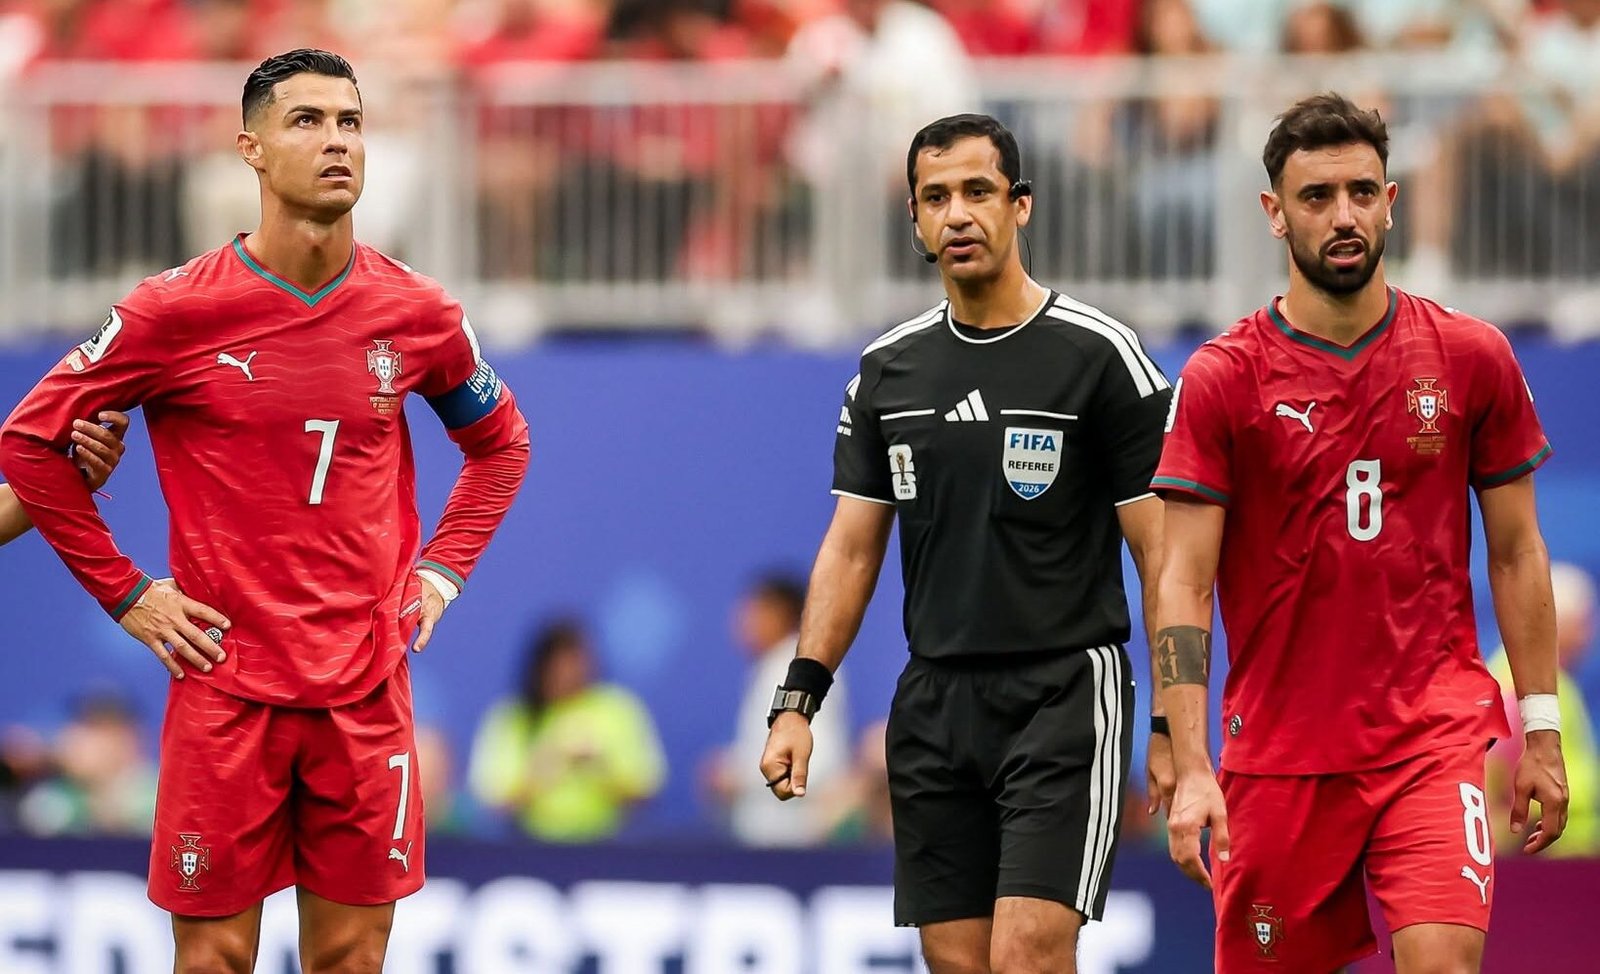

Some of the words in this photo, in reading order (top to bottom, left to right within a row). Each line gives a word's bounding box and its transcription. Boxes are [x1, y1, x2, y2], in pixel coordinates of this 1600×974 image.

[304, 418, 340, 505] 7
[1008, 461, 1055, 472] REFEREE
[1010, 433, 1056, 452] FIFA
[1018, 484, 1040, 493] 2026
[1346, 459, 1382, 542] 8
[388, 752, 410, 840] 7
[1460, 783, 1492, 866] 8
